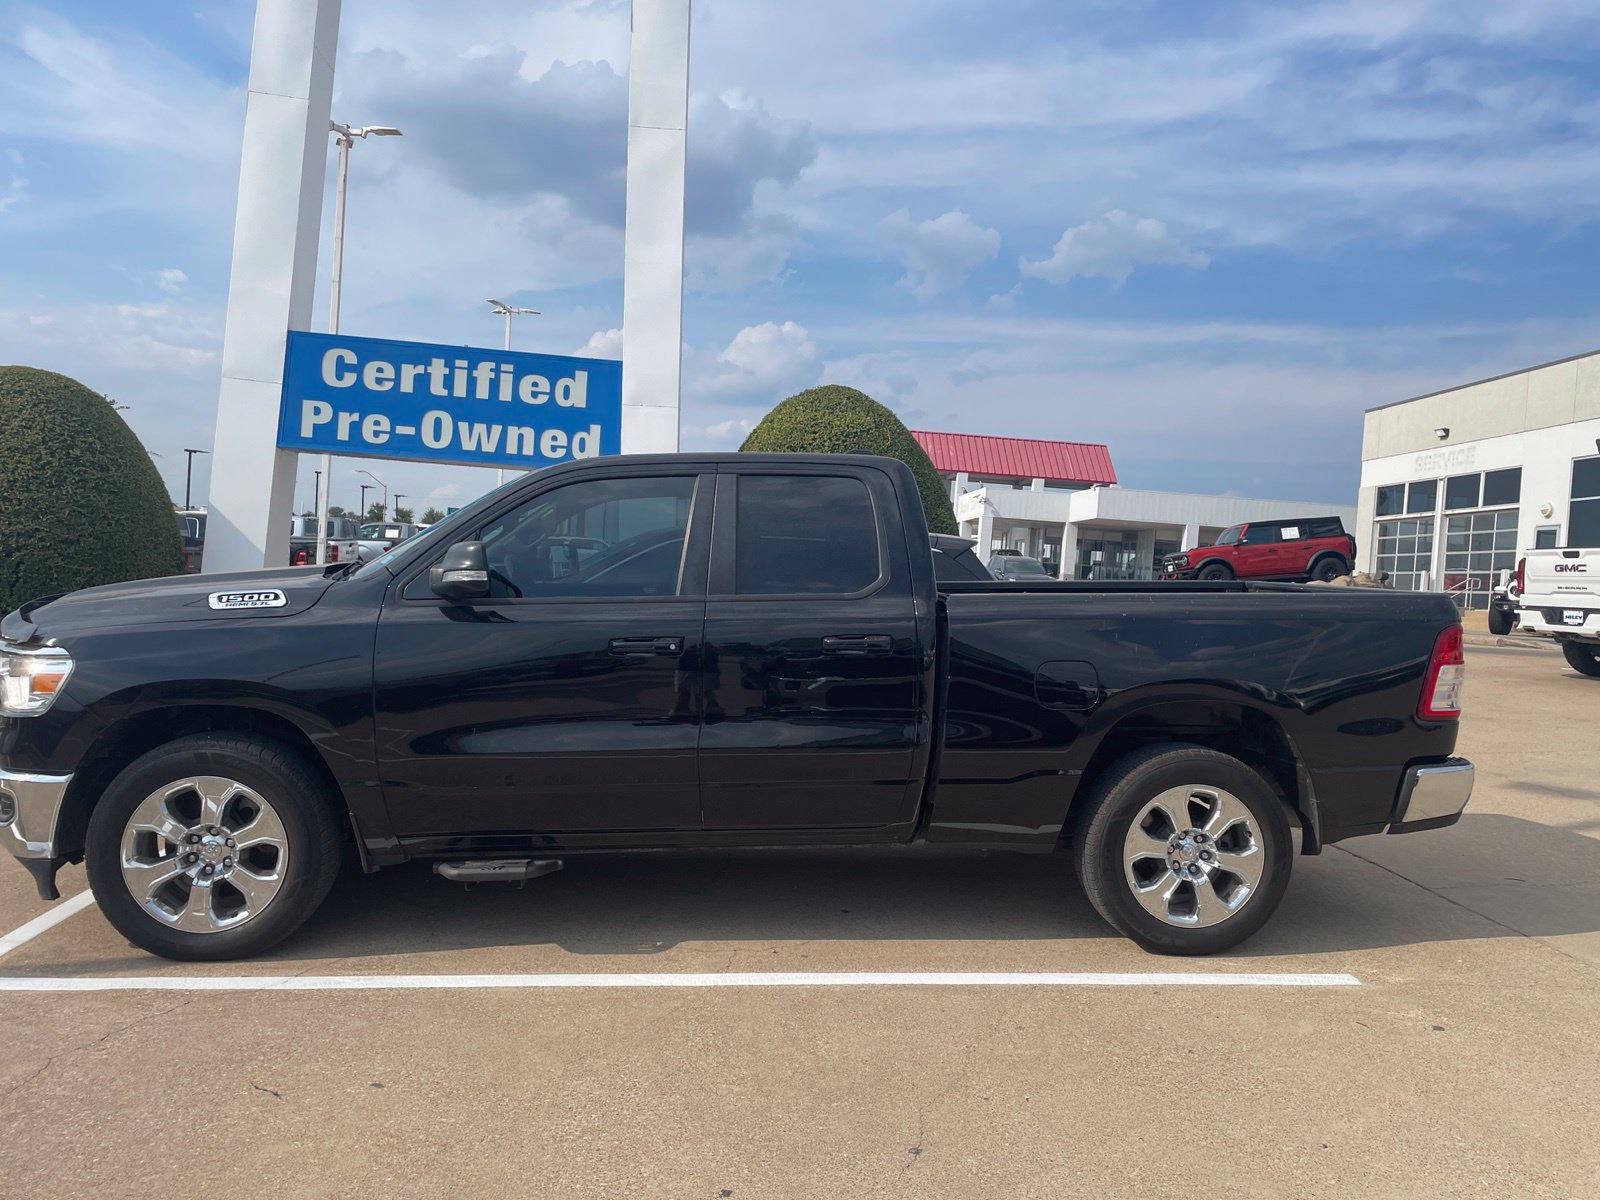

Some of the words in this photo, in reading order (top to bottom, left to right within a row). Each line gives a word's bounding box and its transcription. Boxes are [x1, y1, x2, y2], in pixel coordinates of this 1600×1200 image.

[321, 348, 588, 408] Certified
[300, 399, 601, 460] Pre-Owned
[1415, 447, 1477, 473] SERVICE
[1554, 564, 1587, 573] GMC
[221, 593, 275, 603] 1500
